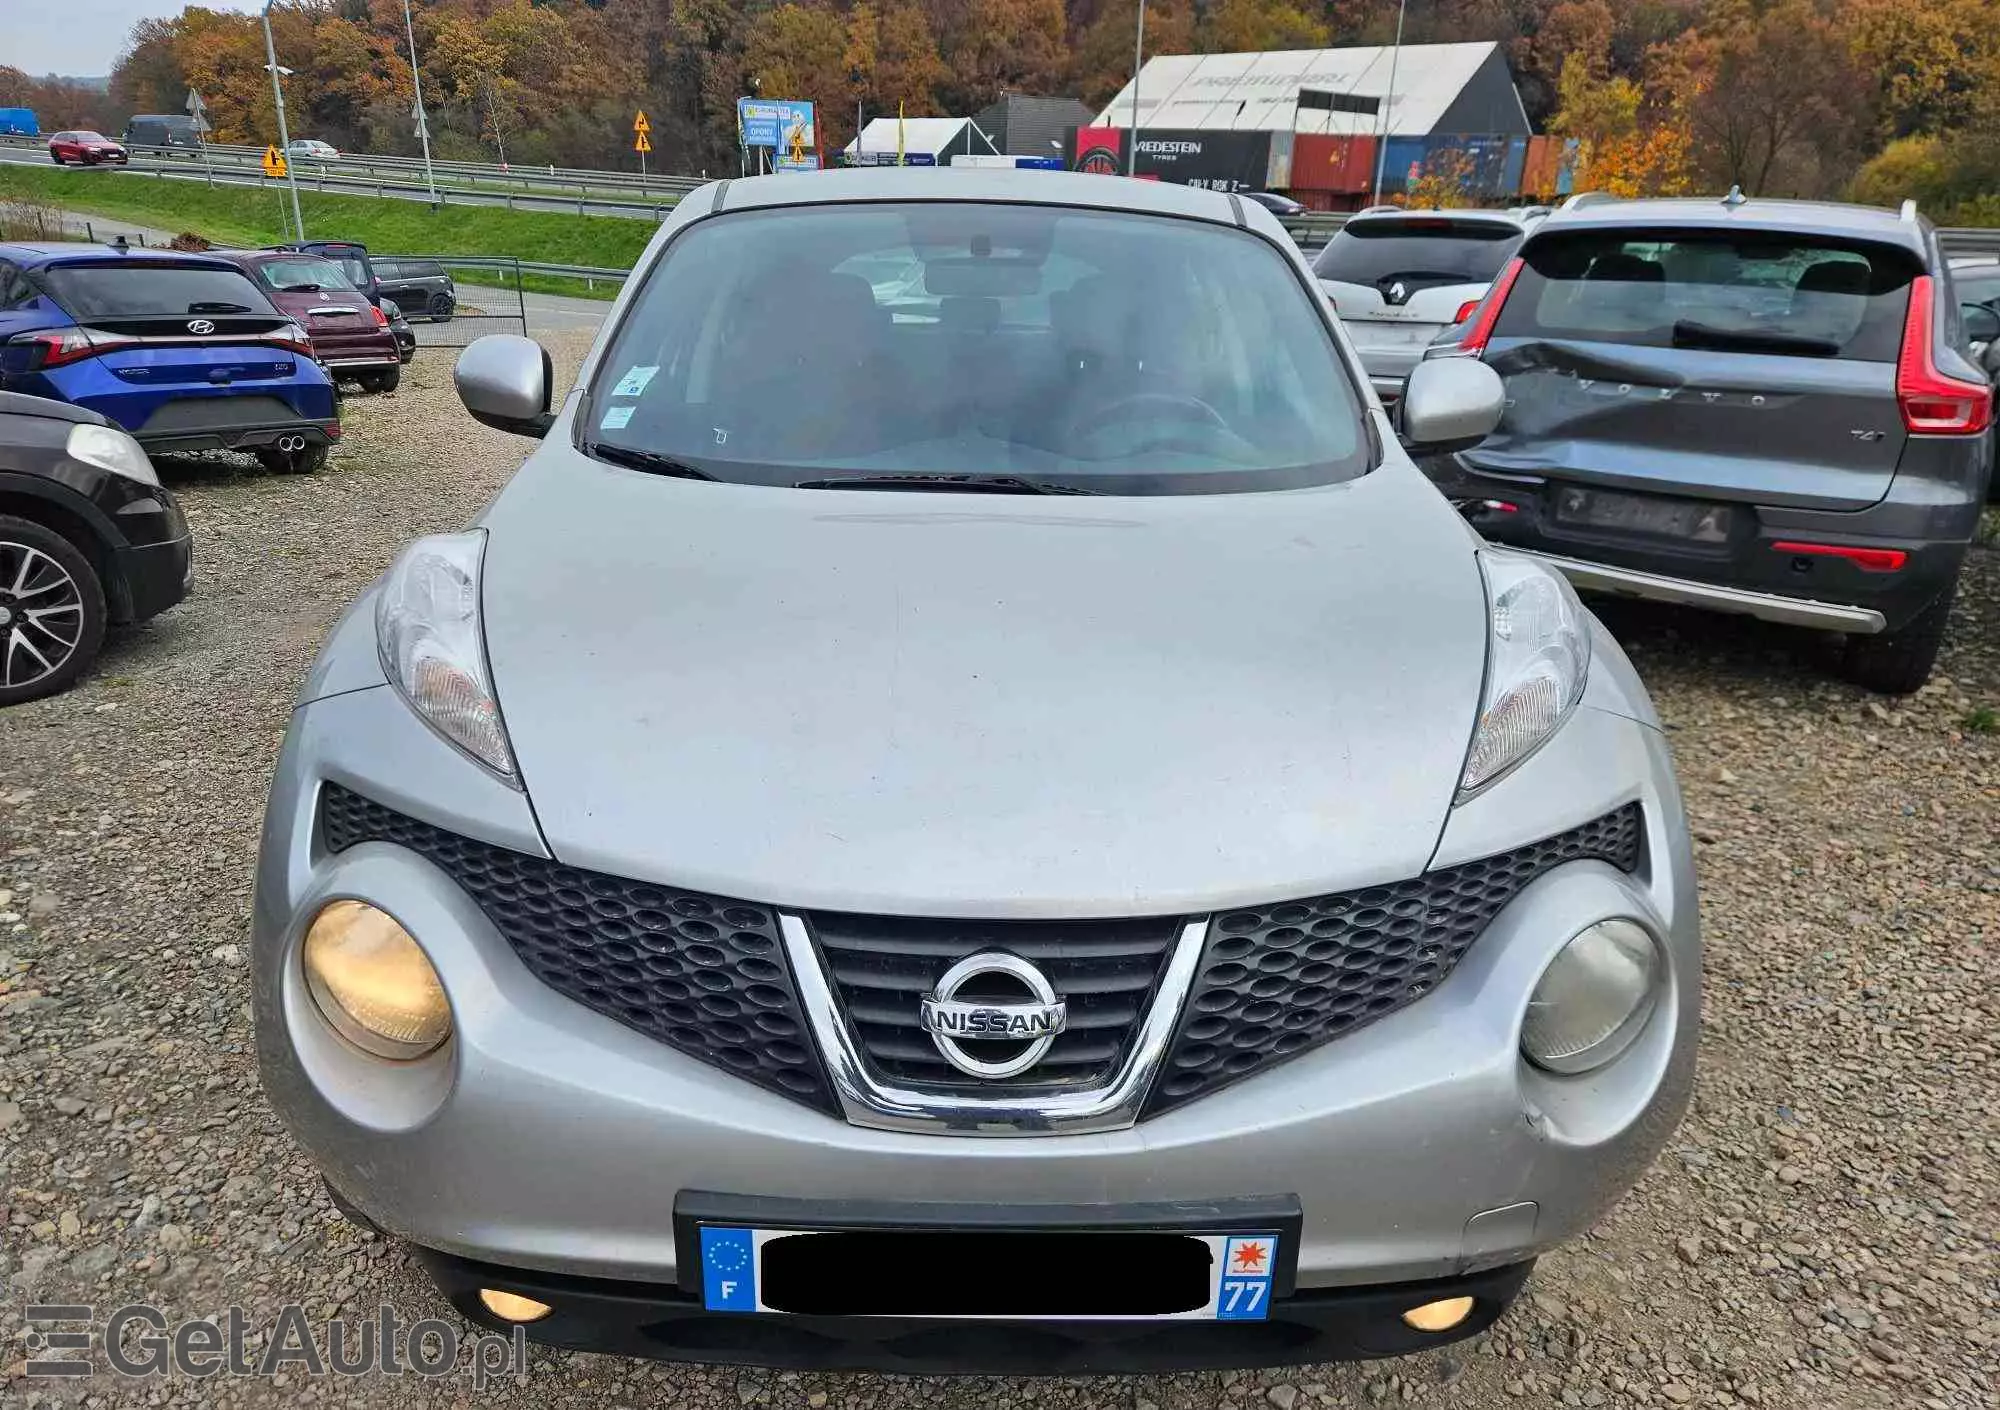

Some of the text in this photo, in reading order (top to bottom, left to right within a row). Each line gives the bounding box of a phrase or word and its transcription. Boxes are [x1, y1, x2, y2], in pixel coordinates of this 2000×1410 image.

[1133, 141, 1202, 153] VREDESTEIN
[936, 1010, 1051, 1033] NISSAN
[721, 1280, 738, 1299] F
[1224, 1281, 1267, 1312] 77
